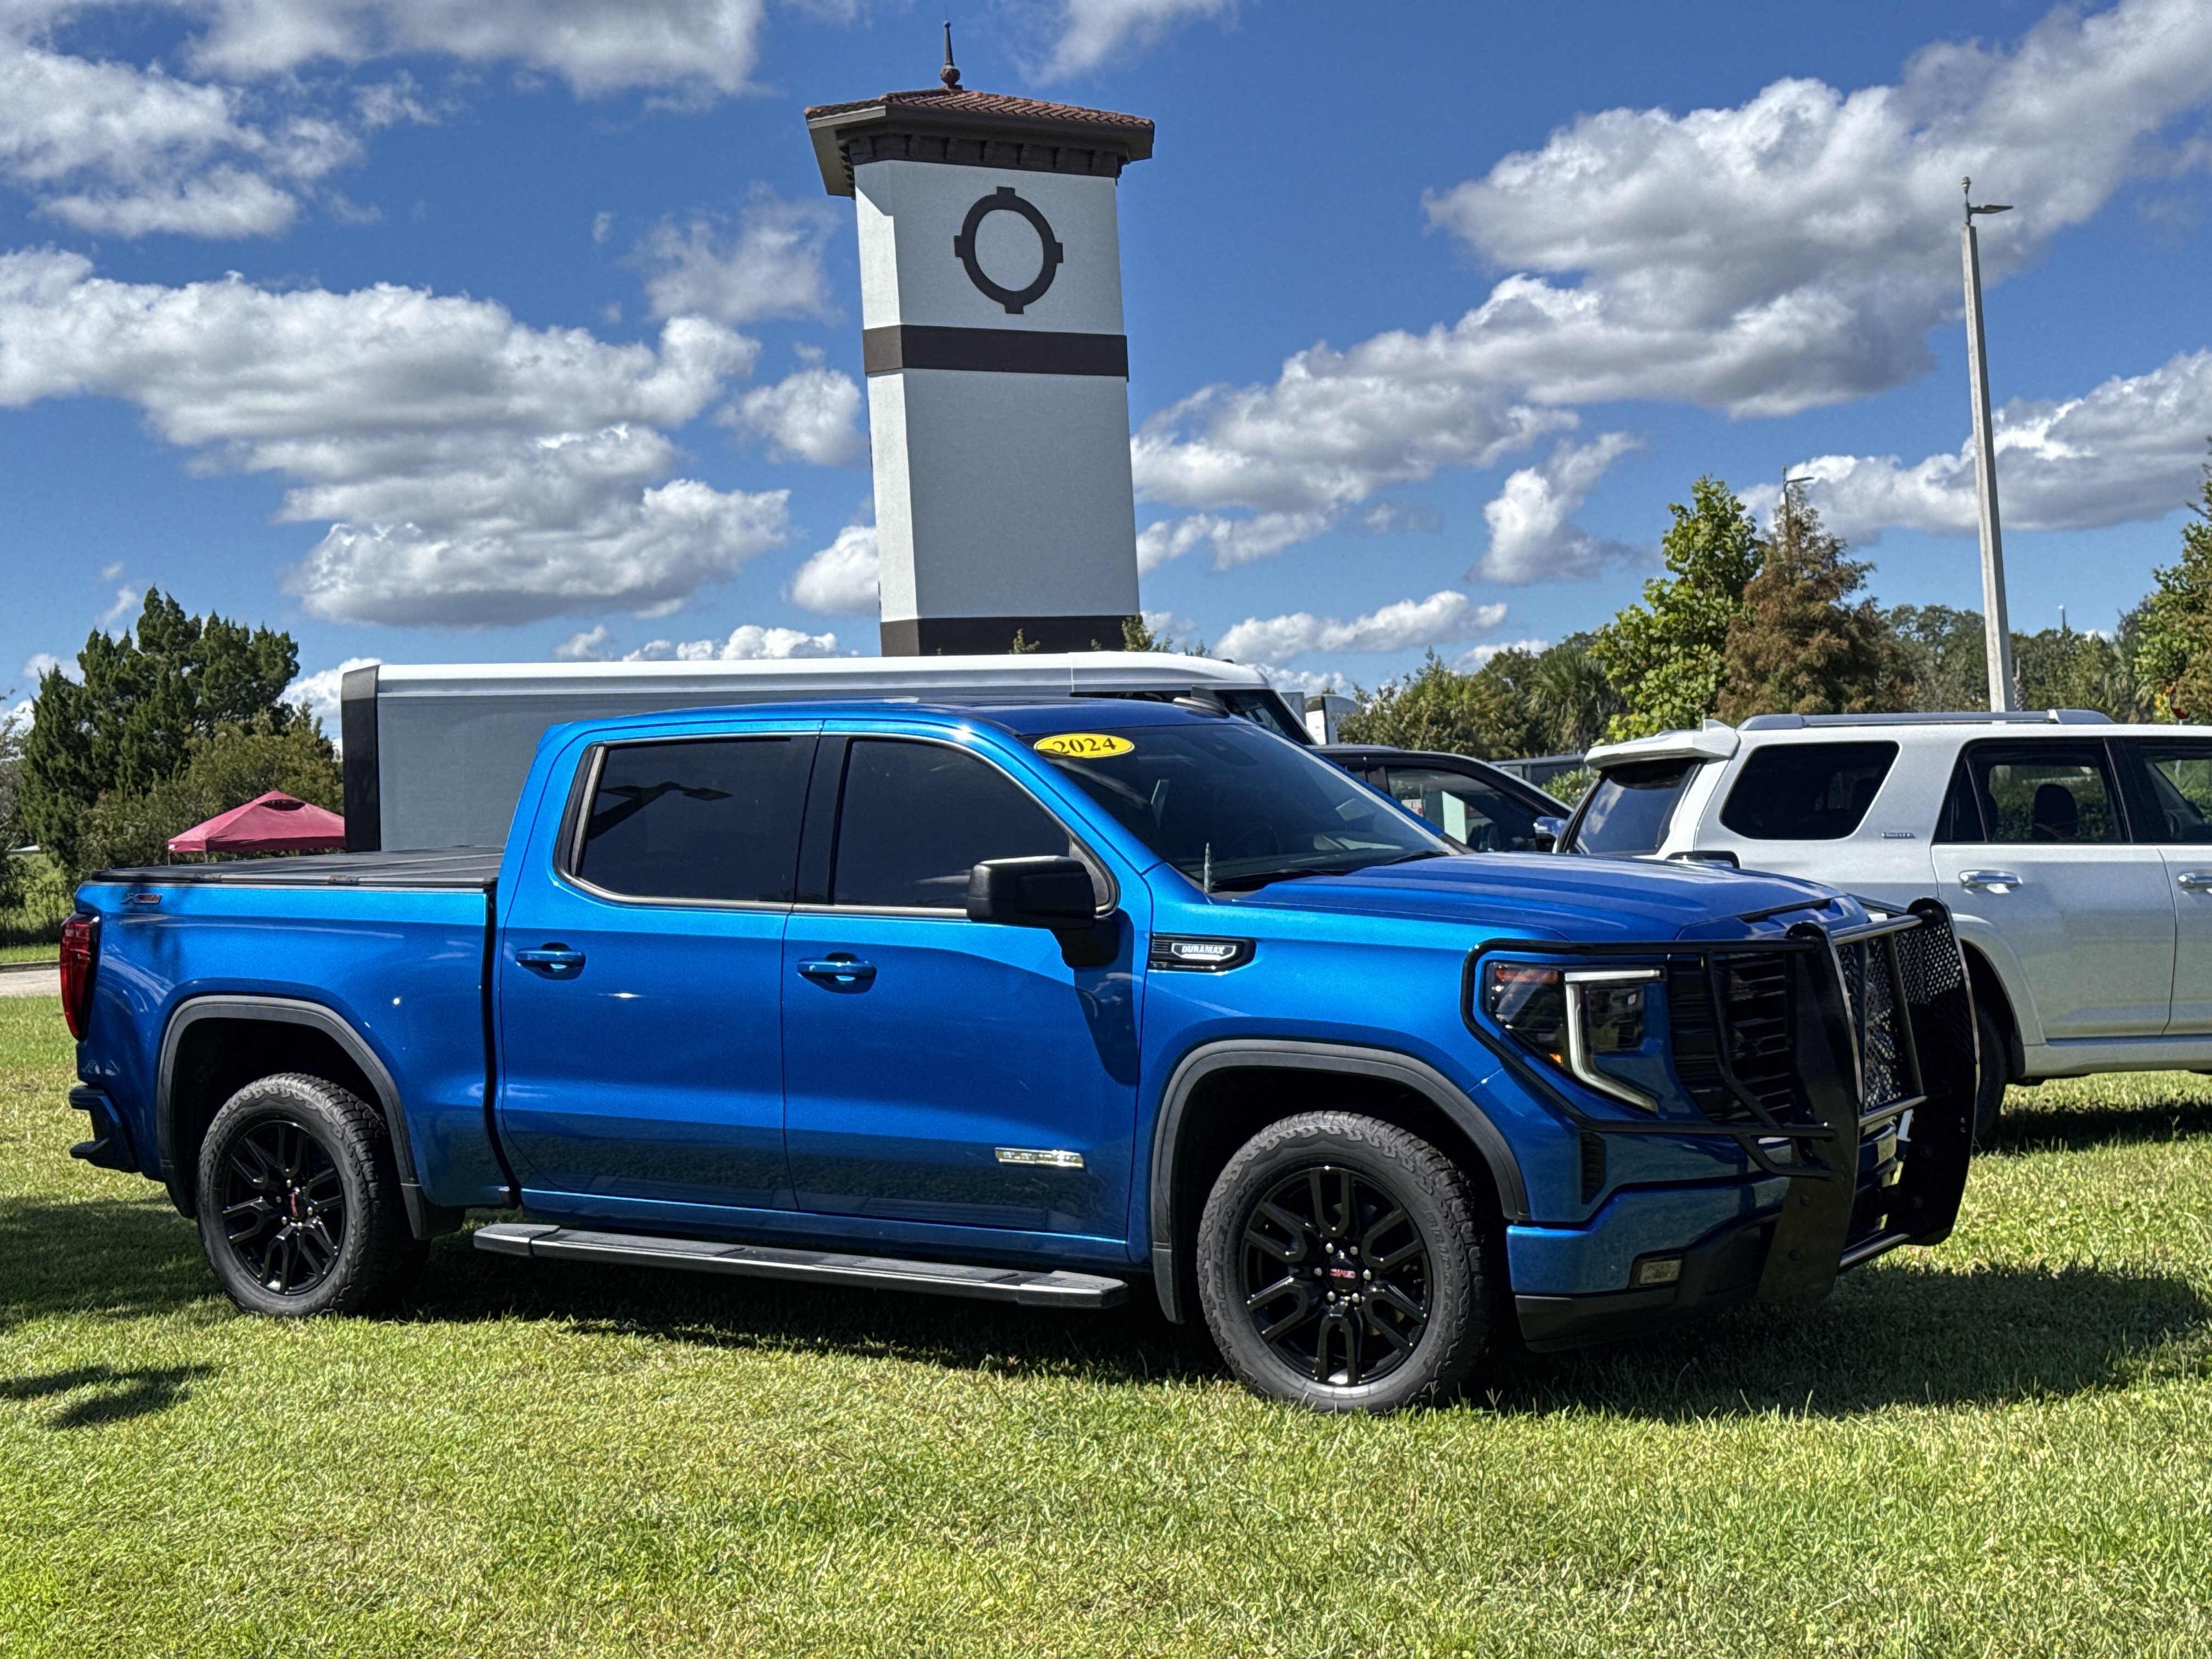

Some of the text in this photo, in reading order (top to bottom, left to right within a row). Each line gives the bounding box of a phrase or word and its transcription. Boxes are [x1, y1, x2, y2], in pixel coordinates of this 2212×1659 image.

[1052, 737, 1116, 754] 2024
[1181, 945, 1226, 955] DURAMAX
[1423, 1210, 1454, 1372] BRIDGESTONE
